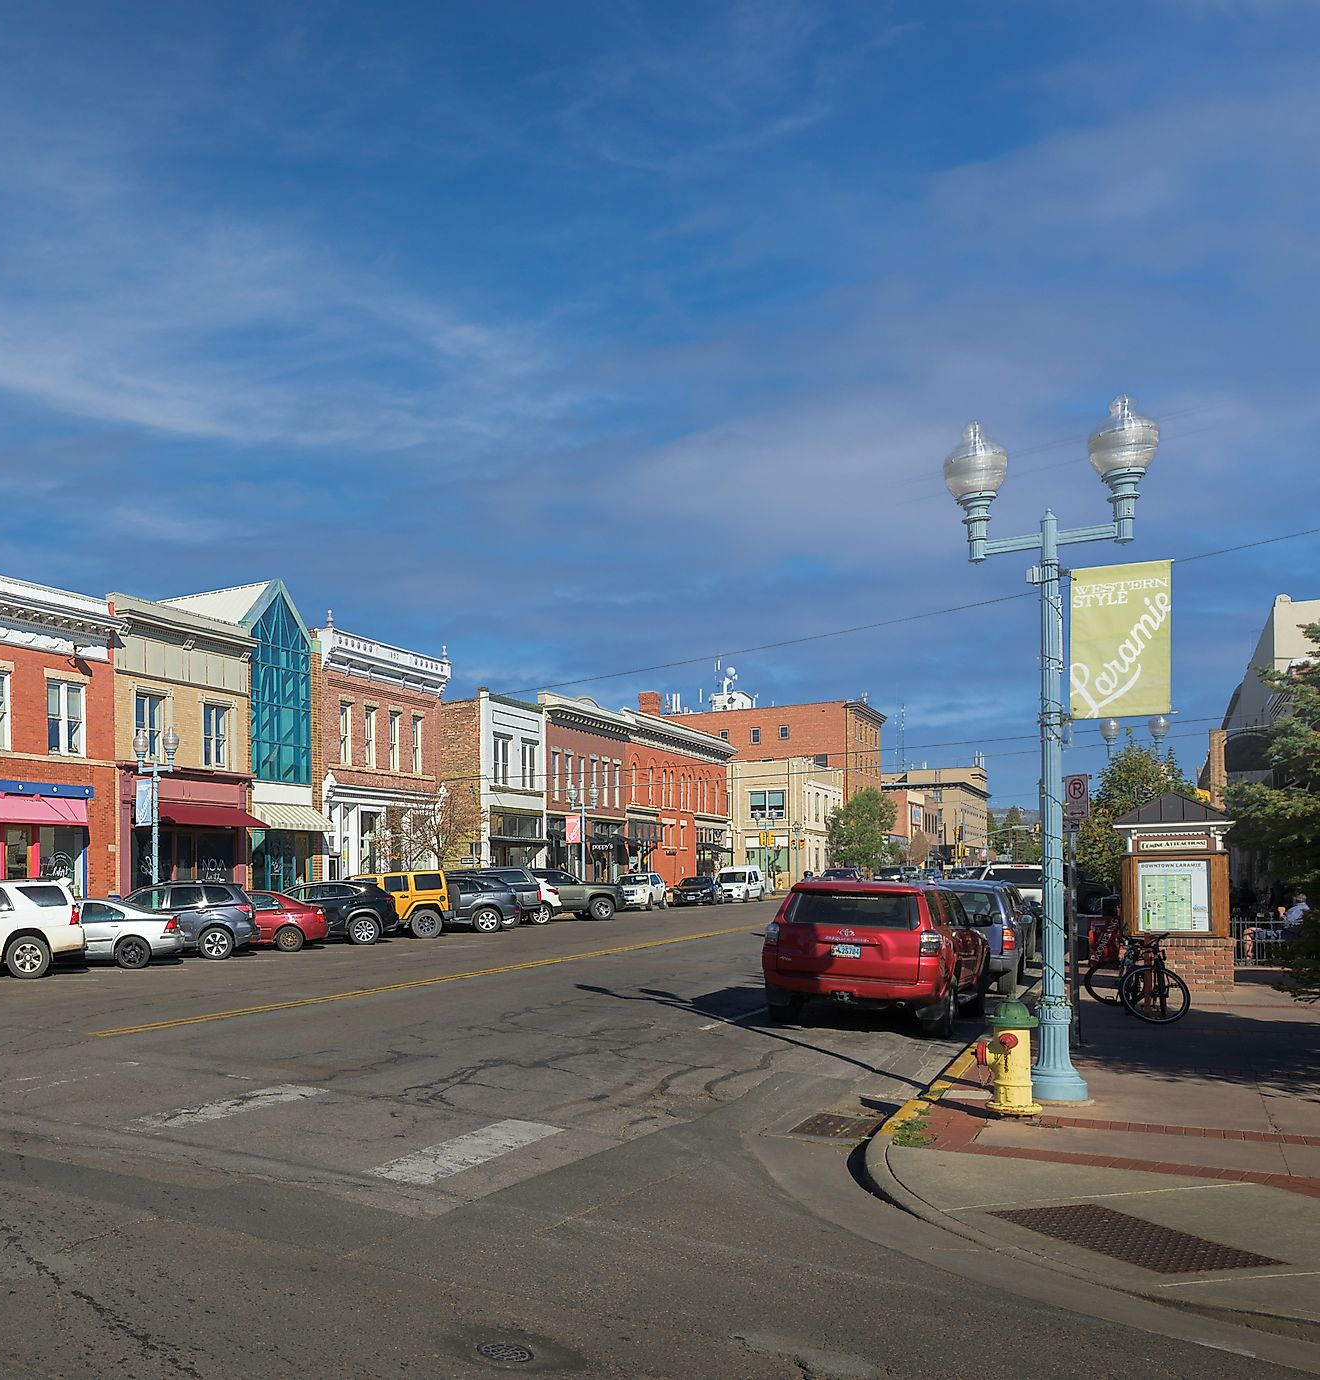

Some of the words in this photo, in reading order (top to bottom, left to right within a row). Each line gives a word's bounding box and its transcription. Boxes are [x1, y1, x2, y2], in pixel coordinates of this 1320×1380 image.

[1073, 577, 1169, 595] WESTERN
[1072, 590, 1129, 608] STYLE
[1070, 592, 1172, 720] Laramie
[591, 843, 614, 851] poppy's
